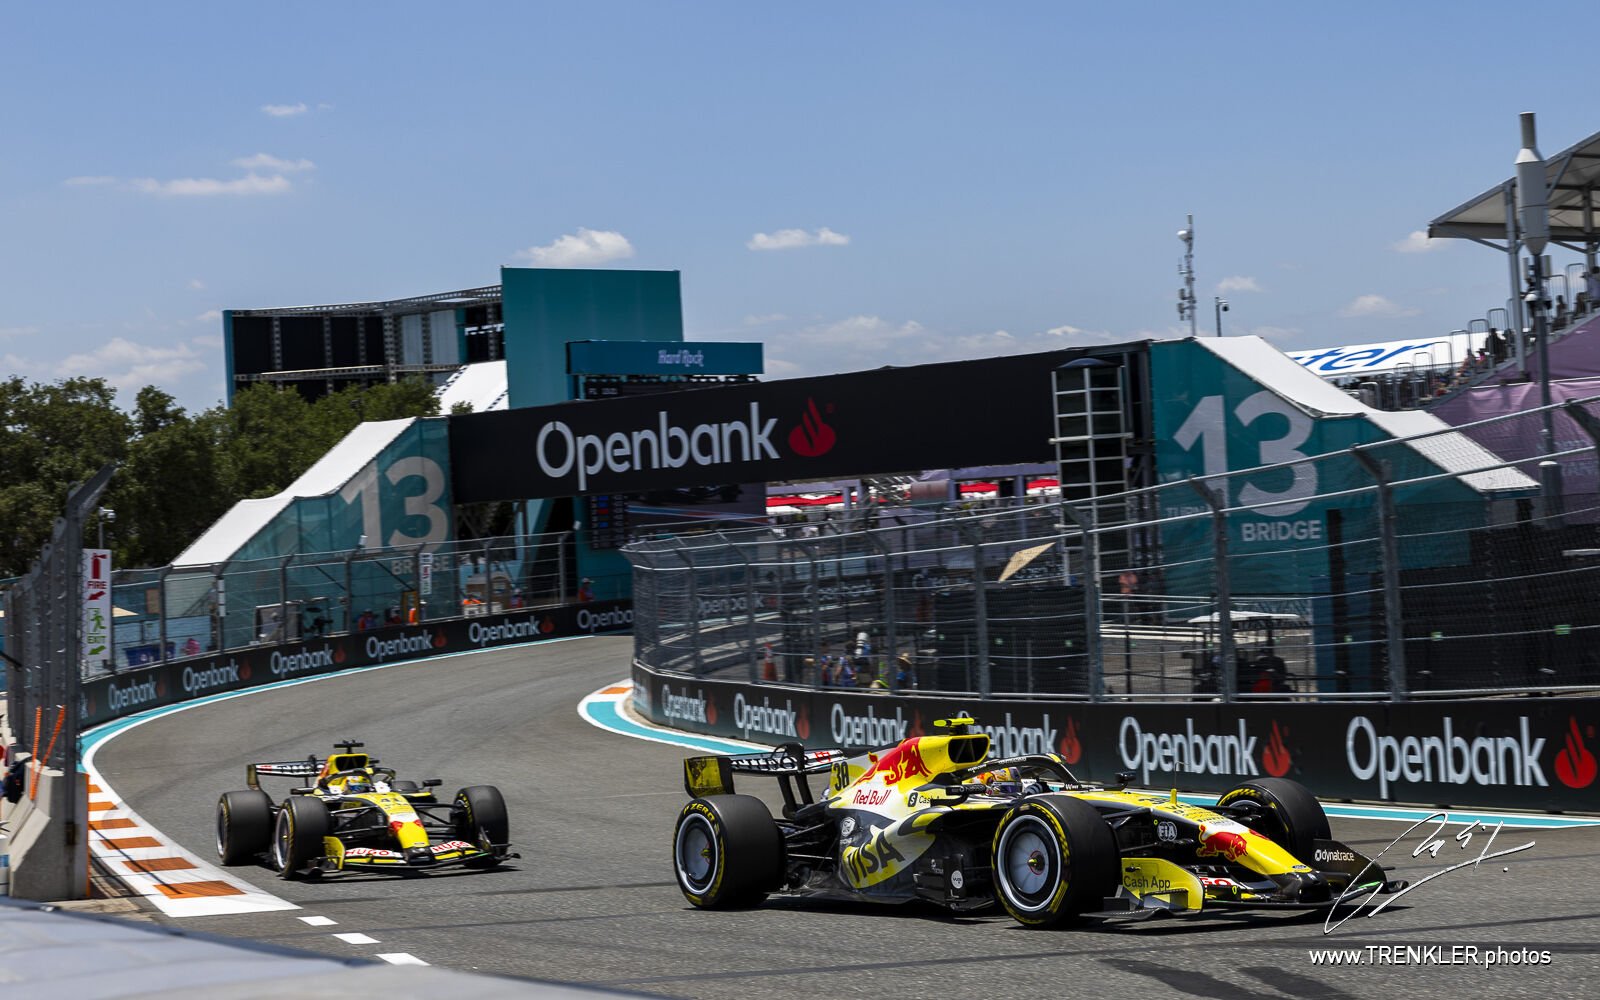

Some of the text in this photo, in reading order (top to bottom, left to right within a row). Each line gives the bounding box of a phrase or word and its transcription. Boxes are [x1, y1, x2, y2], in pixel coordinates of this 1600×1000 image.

[1294, 342, 1434, 371] ter
[536, 401, 780, 491] Openbank
[1172, 390, 1318, 517] 13
[340, 456, 449, 554] 13
[1242, 520, 1322, 541] BRIDGE
[392, 555, 449, 575] BRGE
[87, 581, 107, 590] FIRE
[469, 617, 540, 646] Openbank
[577, 606, 633, 631] Openba
[87, 636, 106, 645] EXIT
[366, 629, 433, 661] Openbank
[270, 644, 334, 678] Openbank
[108, 675, 157, 710] Openbank
[183, 659, 240, 697] Openbank
[661, 684, 708, 726] Openbank
[734, 693, 798, 739] Openbank
[831, 703, 908, 749] Openbank
[1119, 716, 1260, 785] Openbank
[1346, 715, 1550, 799] Openbank
[833, 761, 850, 791] 30
[691, 803, 715, 822] ZERO
[853, 789, 892, 806] Red Bull
[345, 848, 389, 857] HUGO
[433, 840, 470, 853] HUGO
[847, 831, 905, 884] VISA
[1322, 850, 1355, 862] dynatrace
[1123, 876, 1171, 889] Cash App
